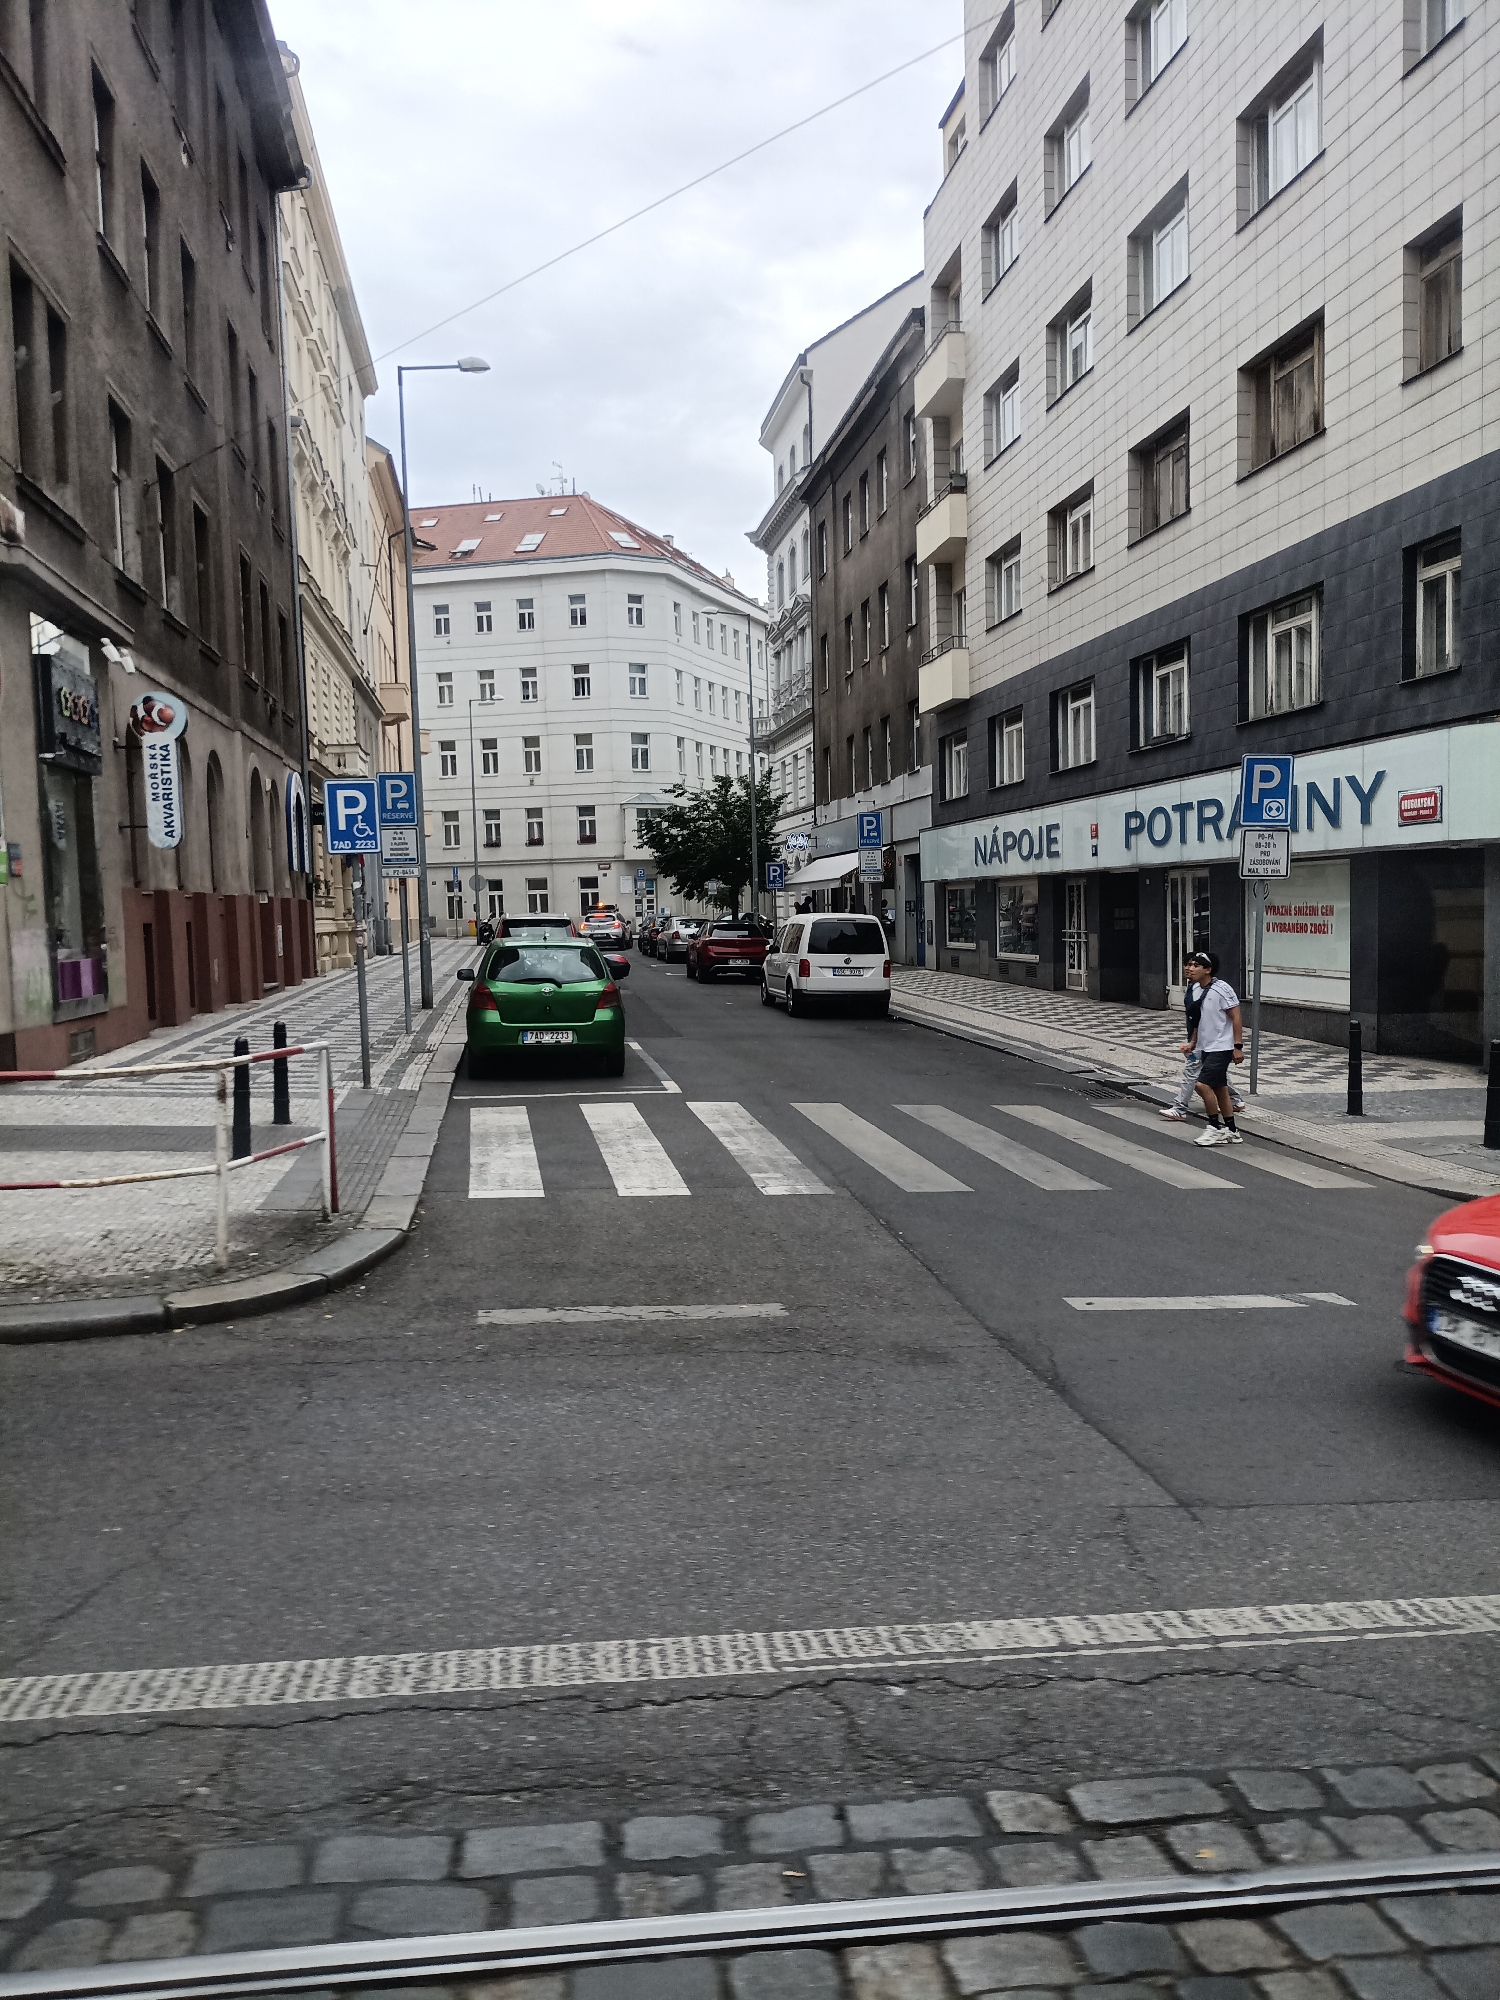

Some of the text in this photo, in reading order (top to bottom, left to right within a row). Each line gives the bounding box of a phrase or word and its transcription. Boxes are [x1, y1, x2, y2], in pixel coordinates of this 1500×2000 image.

[147, 743, 160, 802] MOŘSKÁ
[159, 743, 176, 839] AKVARISTIKA
[385, 779, 408, 810] P
[1251, 764, 1282, 804] P
[336, 789, 368, 831] P
[863, 816, 877, 837] P
[332, 840, 376, 850] 7AD 2233
[974, 823, 1061, 867] NÁPOJE
[1249, 857, 1282, 866] ZÁSOBOVÁNÍ
[769, 866, 780, 881] P
[1265, 901, 1335, 917] VÝRAZNÉ SNÍŽENÍ CEN
[1266, 922, 1271, 933] U
[1272, 920, 1309, 934] VYBRANÉHO
[1309, 919, 1329, 935] ZBOŽÍ
[529, 1031, 569, 1040] 7AD 2233
